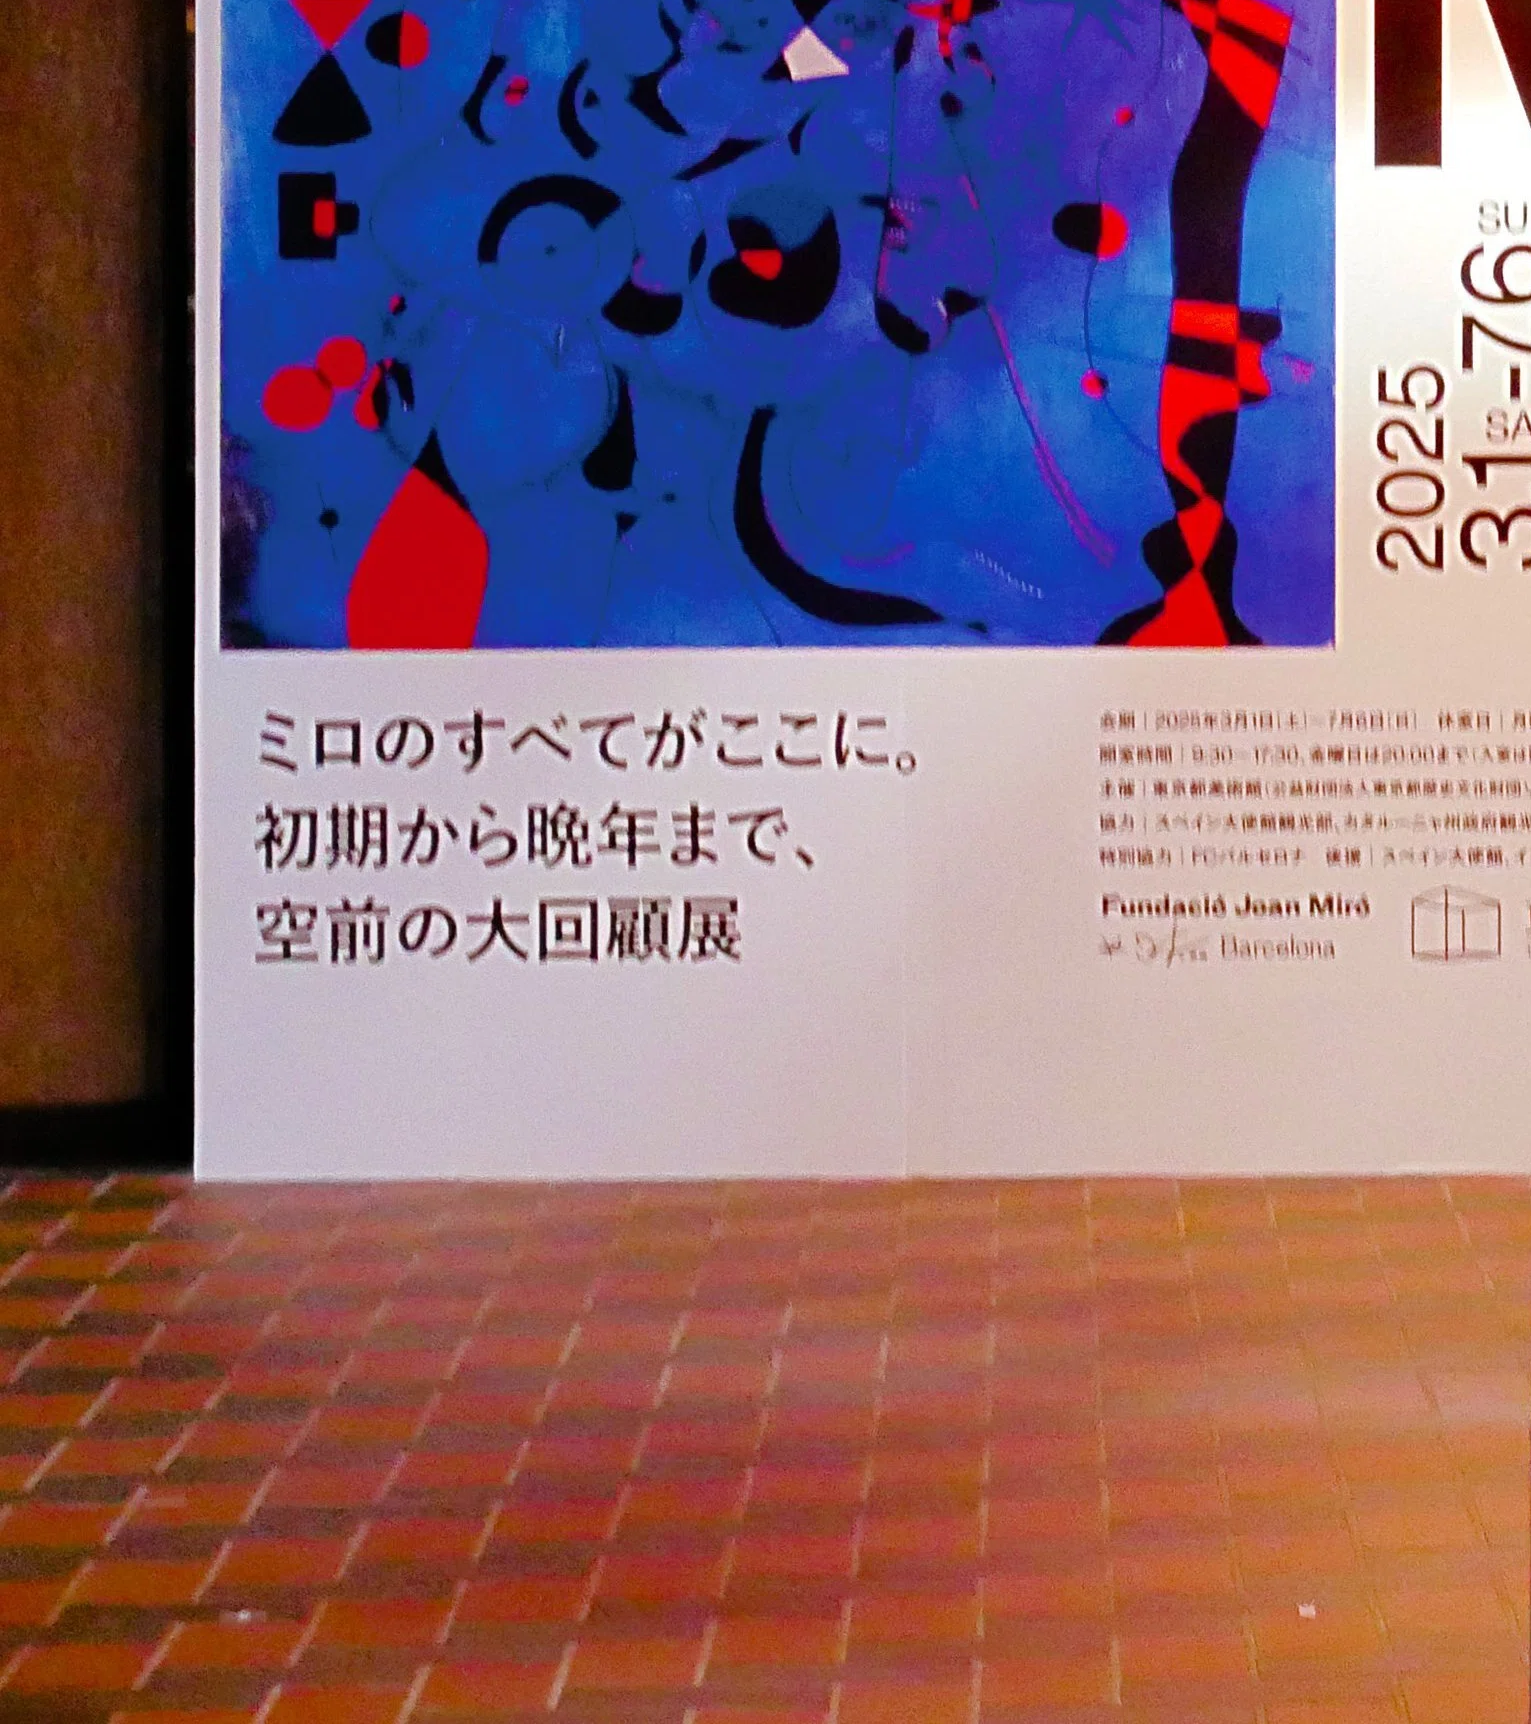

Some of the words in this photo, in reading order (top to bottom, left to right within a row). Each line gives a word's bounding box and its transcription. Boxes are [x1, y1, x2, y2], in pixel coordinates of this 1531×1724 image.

[1377, 364, 1445, 574] 2025
[255, 708, 917, 775] ミロのすべてがここに。
[254, 802, 816, 870] 初期から晩年まで、
[254, 895, 743, 965] 空前の大回顧展
[1235, 893, 1301, 918] Joan
